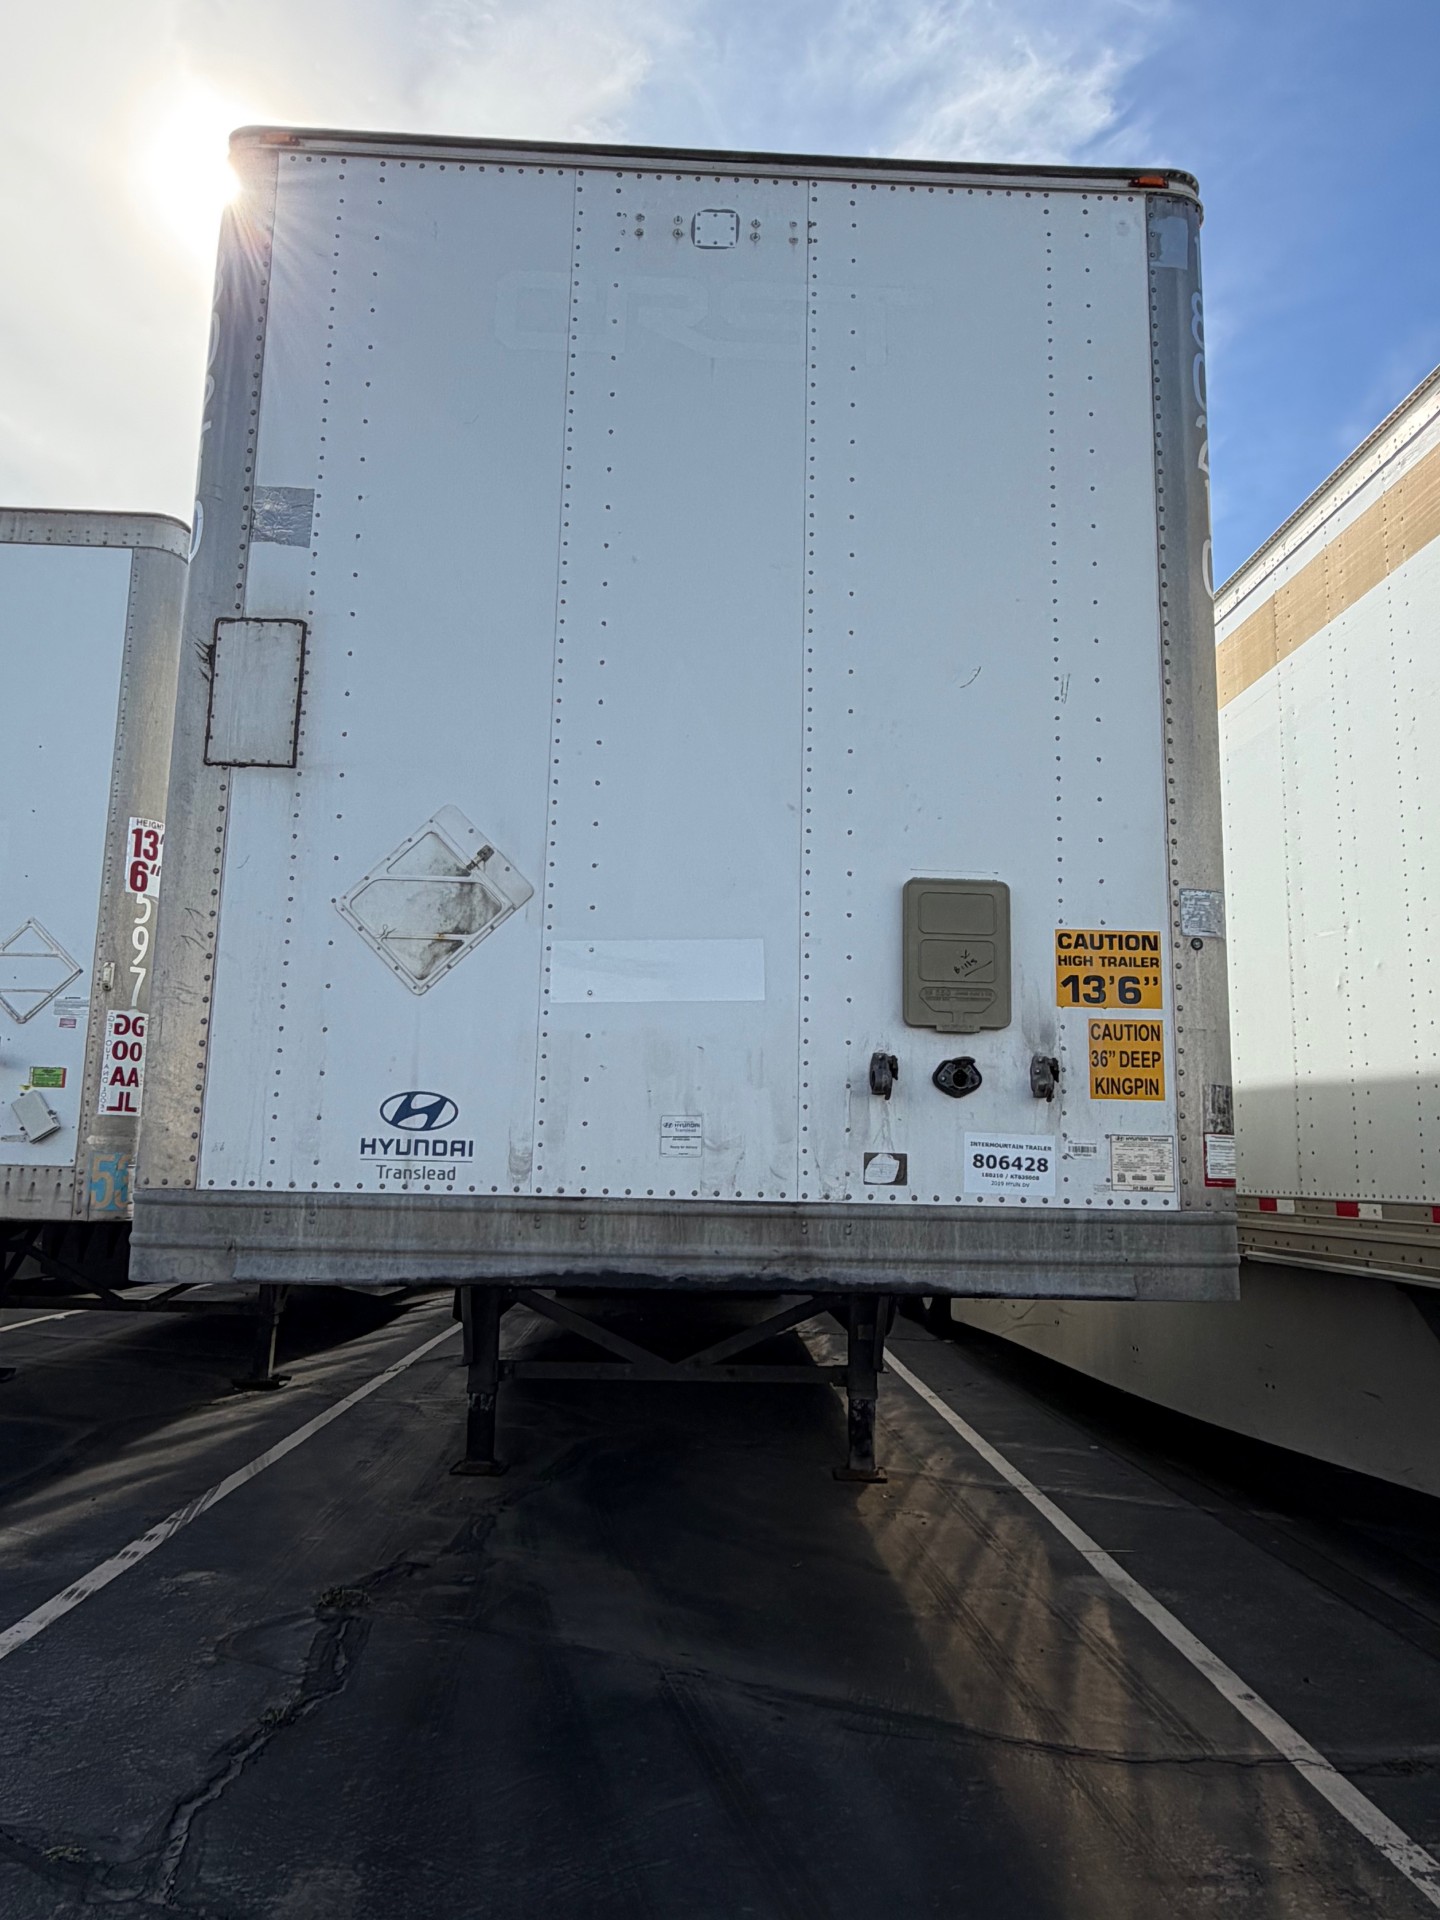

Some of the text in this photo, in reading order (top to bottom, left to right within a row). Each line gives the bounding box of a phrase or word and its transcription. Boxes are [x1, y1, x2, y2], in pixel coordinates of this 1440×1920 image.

[1057, 931, 1159, 952] CAUTION
[1057, 954, 1160, 969] HIGH TRAILER
[1089, 1022, 1161, 1042] CAUTION
[1118, 1050, 1161, 1069] DEEP
[1094, 1077, 1160, 1096] KINGPIN
[359, 1137, 474, 1158] HYUNDAI
[970, 1141, 1052, 1152] INTERMOUNTAIN TRAILER
[375, 1164, 456, 1181] Translead
[972, 1153, 1049, 1173] 806428
